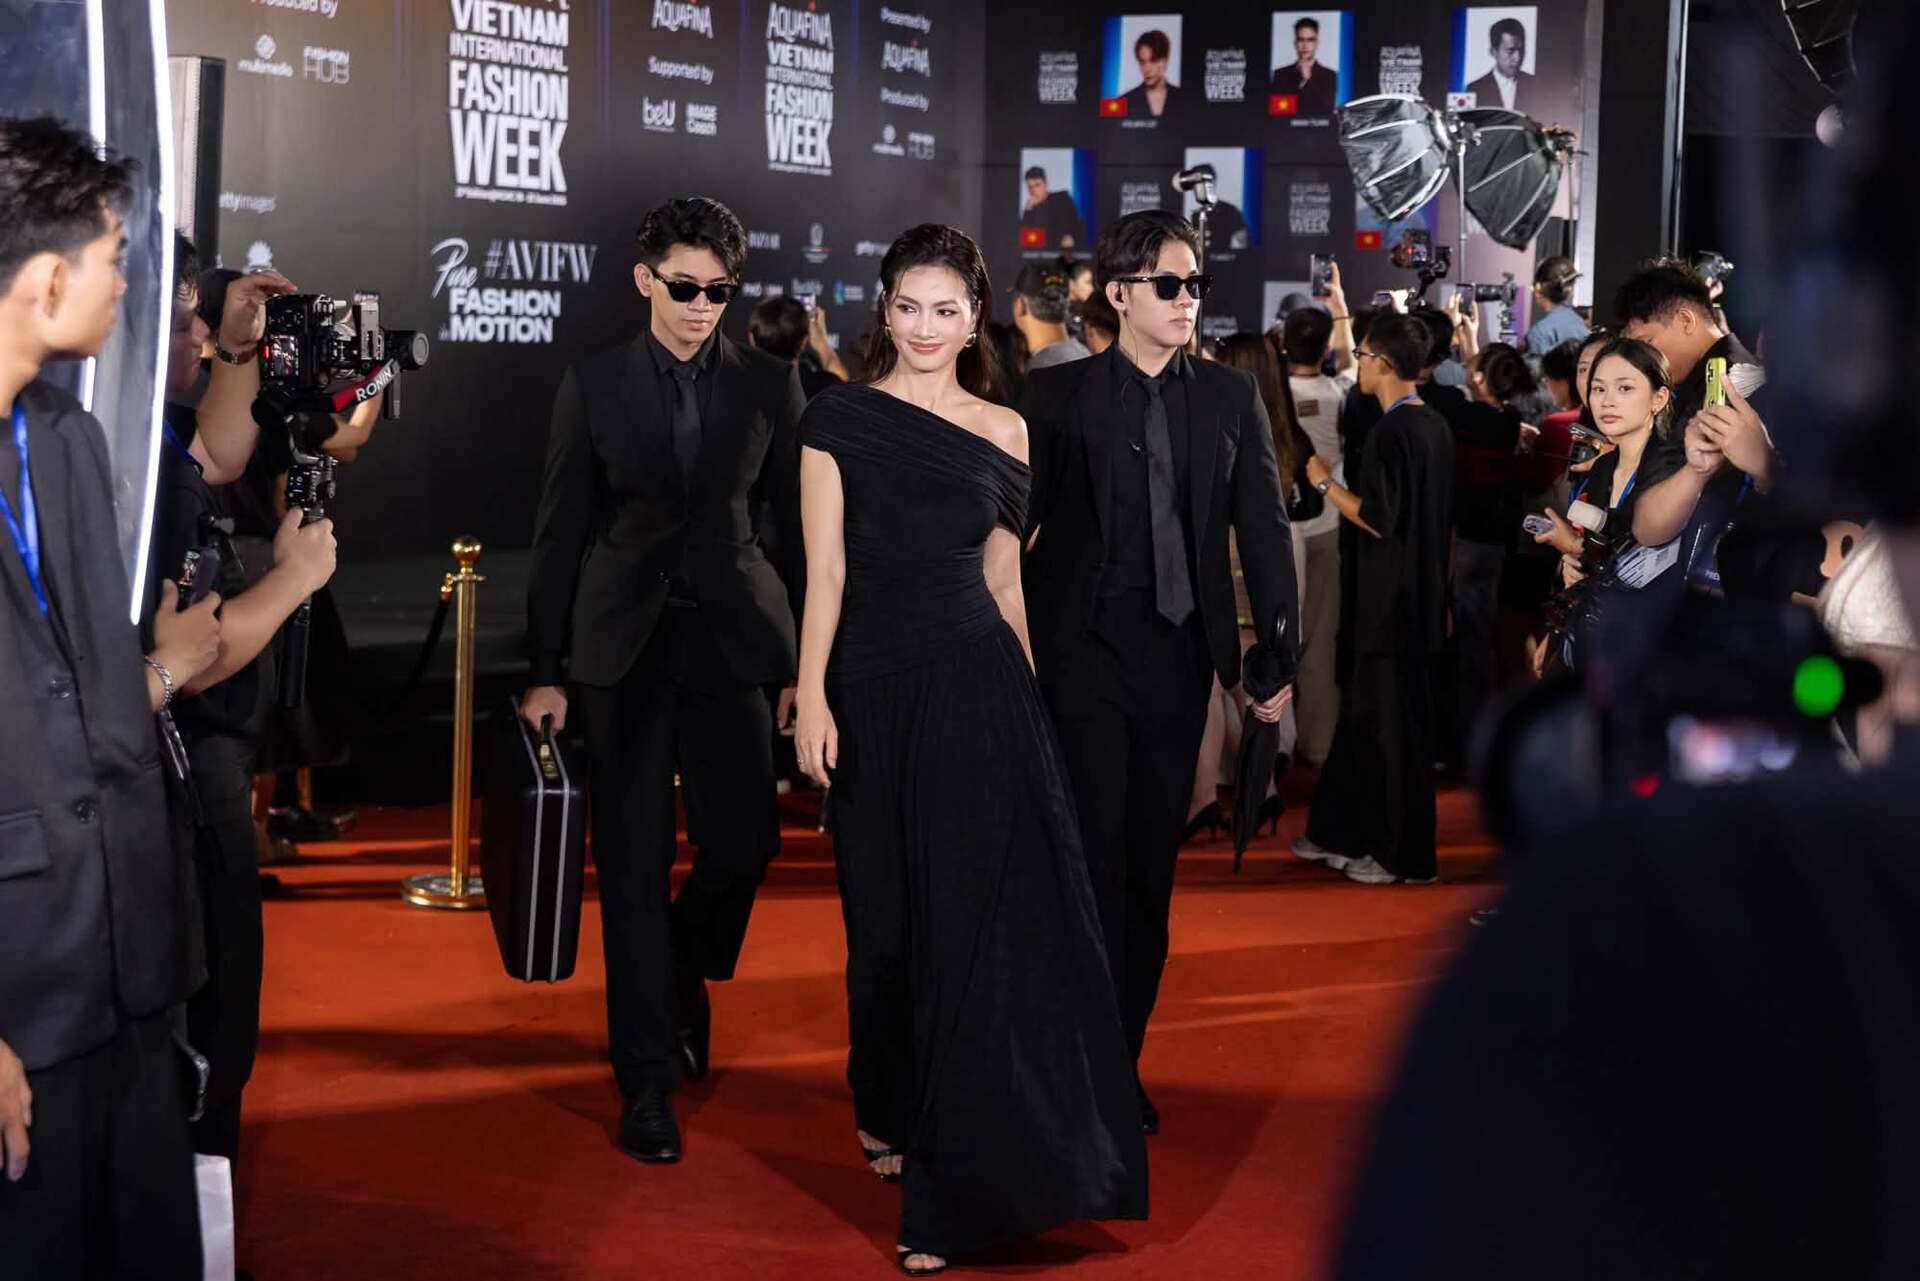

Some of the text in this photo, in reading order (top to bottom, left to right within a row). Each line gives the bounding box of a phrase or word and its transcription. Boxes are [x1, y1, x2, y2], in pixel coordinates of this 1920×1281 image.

[450, 0, 568, 47] VIETNAM
[652, 0, 713, 39] AQUAFINA
[766, 2, 833, 51] AQUAFINA
[449, 32, 568, 73] INTERNATIONAL
[648, 56, 714, 85] Supported by
[767, 41, 834, 74] VIETNAM
[449, 60, 568, 121] FASHION
[766, 83, 833, 121] FASHION
[1205, 84, 1245, 99] WEEK
[449, 108, 568, 192] WEEK
[766, 114, 832, 168] WEEK
[485, 239, 599, 283] #AVIFW
[449, 287, 561, 317] FASHION
[450, 314, 553, 343] MOTION
[355, 358, 395, 401] RONIN
